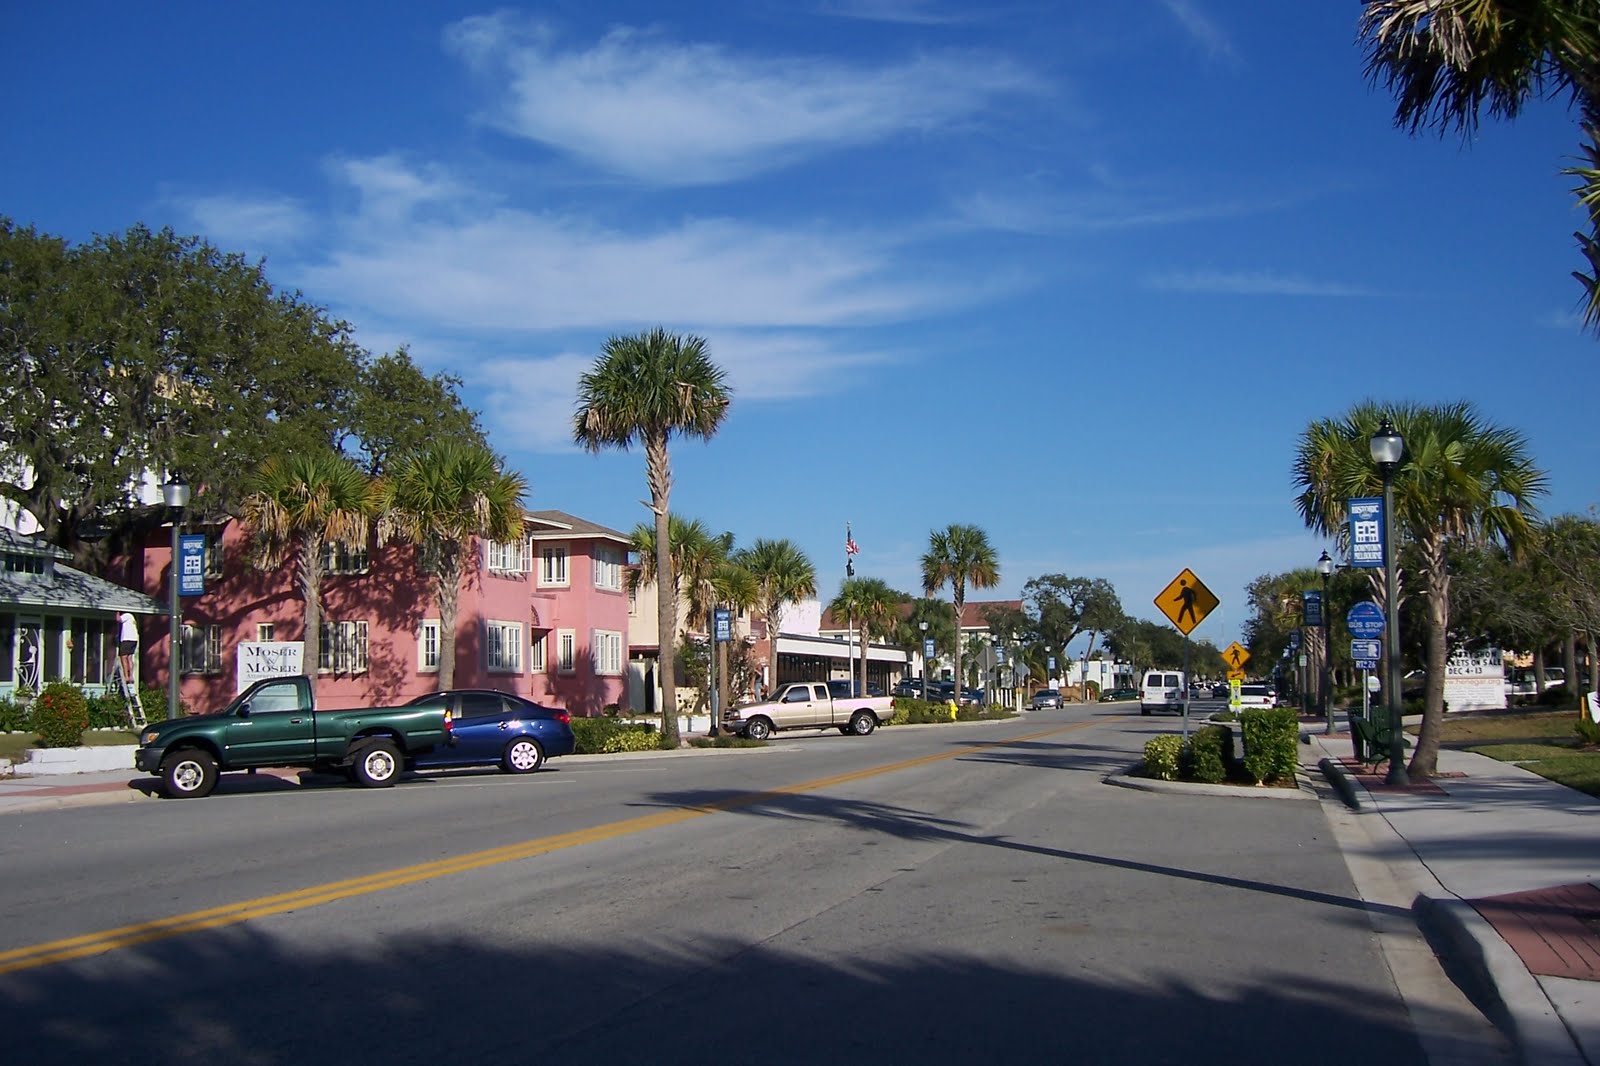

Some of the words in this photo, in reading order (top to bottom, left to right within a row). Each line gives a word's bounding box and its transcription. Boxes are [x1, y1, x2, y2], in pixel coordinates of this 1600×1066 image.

[246, 646, 297, 656] MOSER
[267, 657, 275, 665] &
[1368, 660, 1376, 668] 26
[246, 662, 297, 672] MOSER
[1448, 667, 1463, 675] DEC
